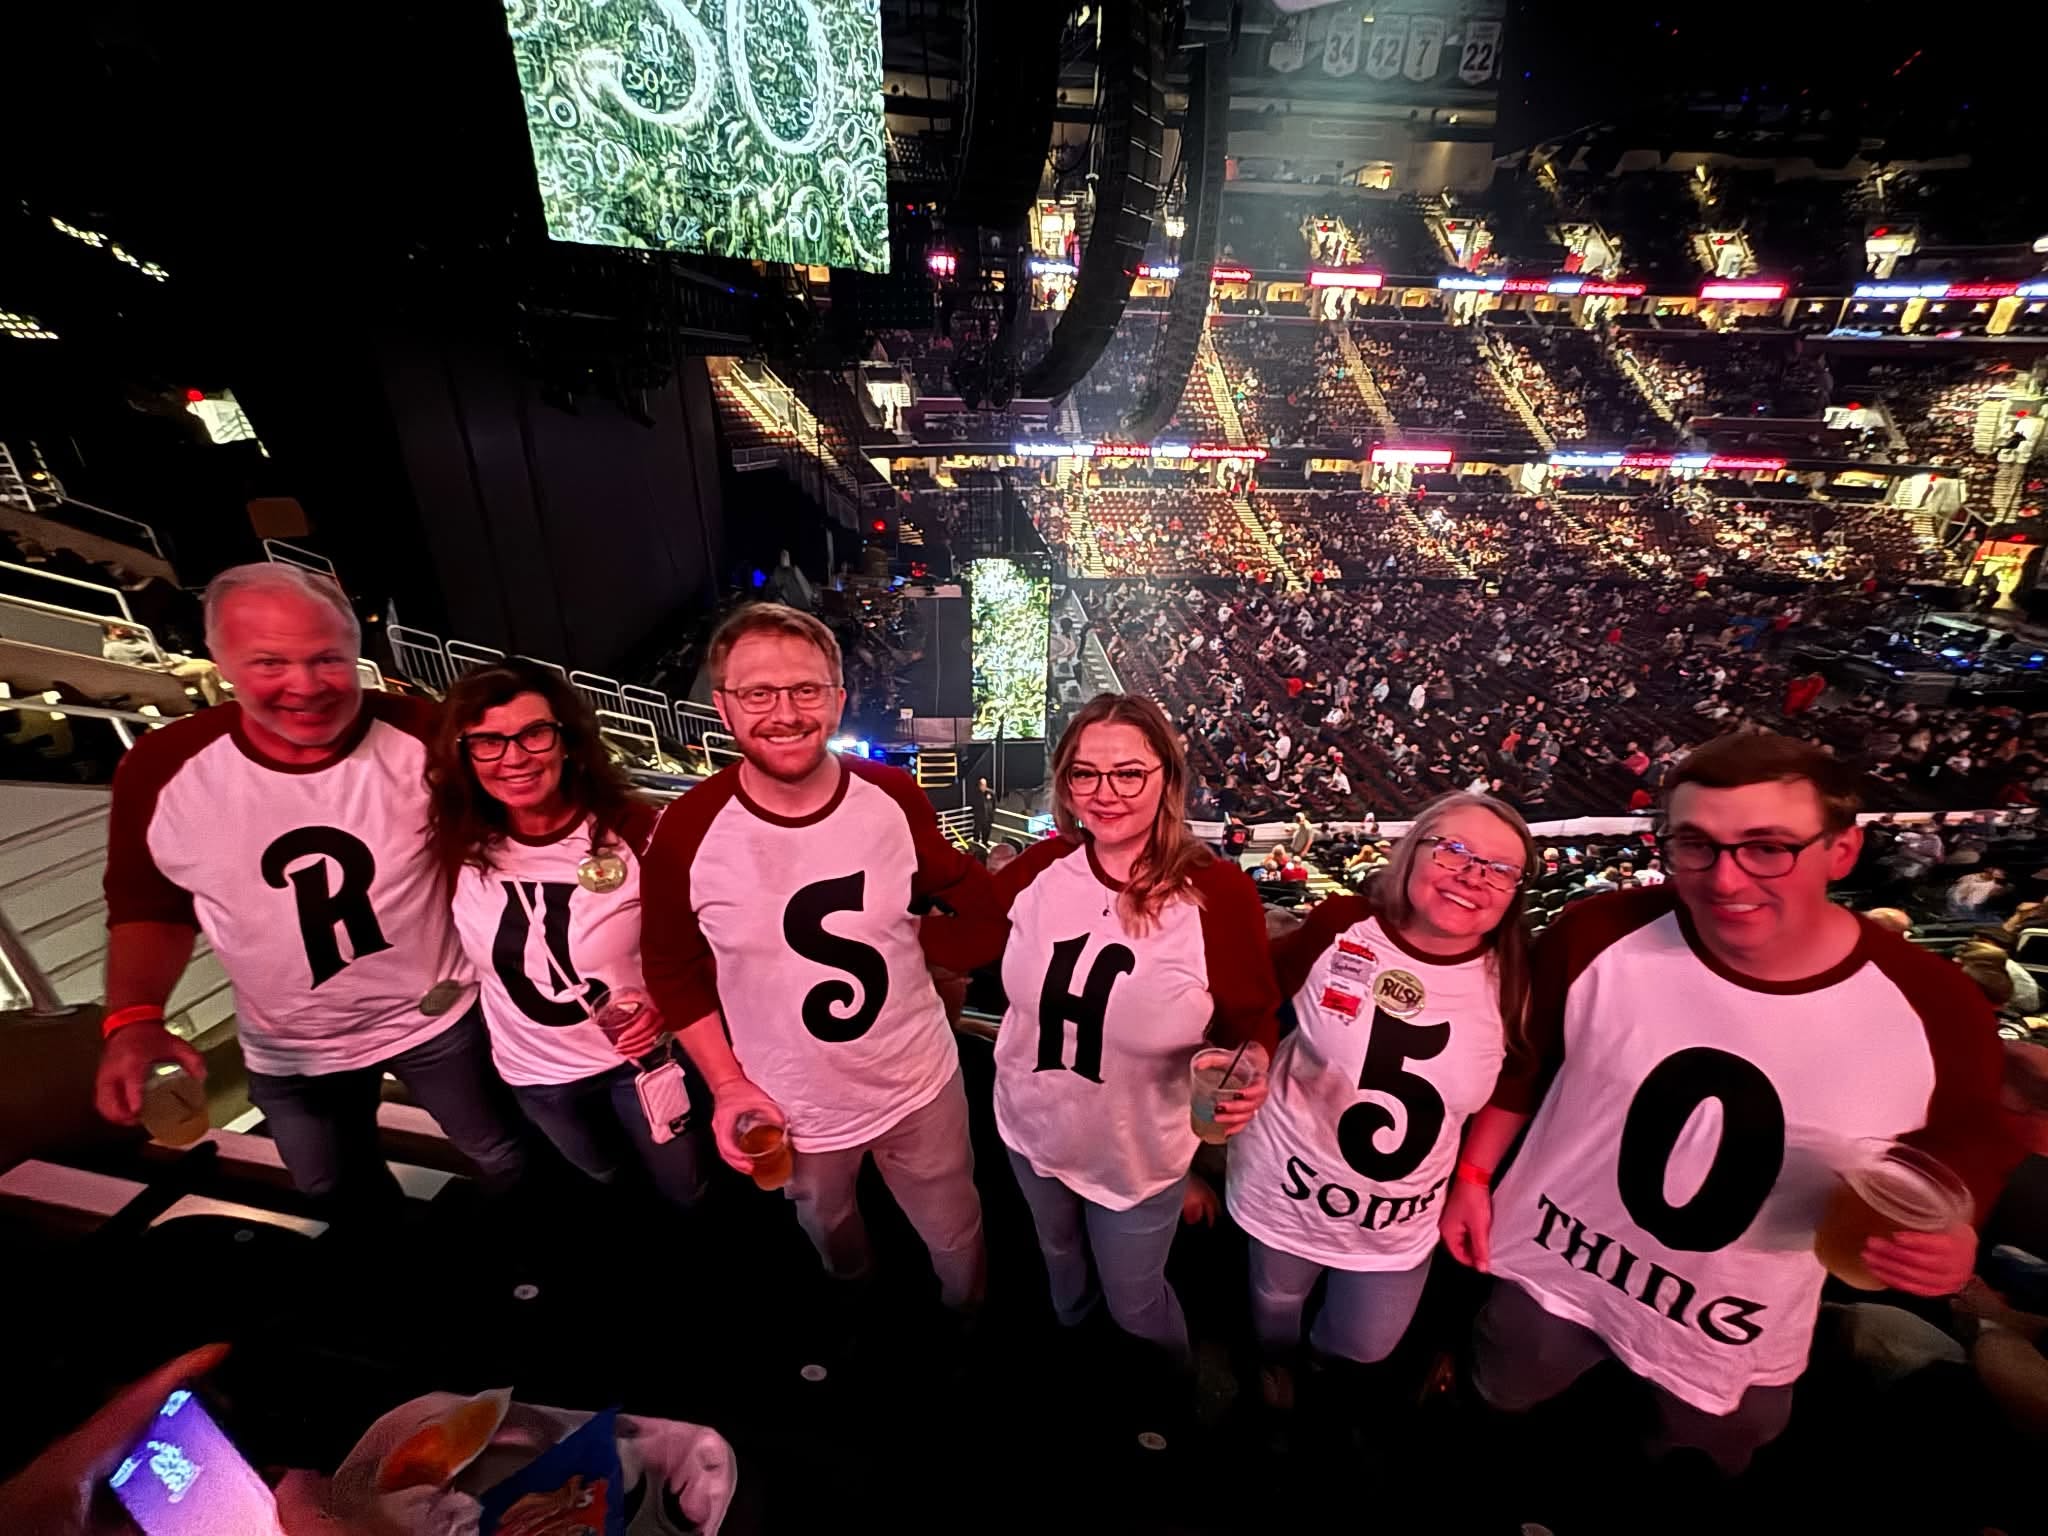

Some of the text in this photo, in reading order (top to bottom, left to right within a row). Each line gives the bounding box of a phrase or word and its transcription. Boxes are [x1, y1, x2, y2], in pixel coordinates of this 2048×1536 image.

[1415, 37, 1433, 65] 7
[1462, 43, 1492, 72] 22
[261, 825, 394, 990] R
[492, 879, 611, 1027] U
[783, 870, 889, 1043] S
[1032, 932, 1136, 1084] H
[1379, 978, 1422, 1009] RUSH
[1337, 1005, 1451, 1182] 5
